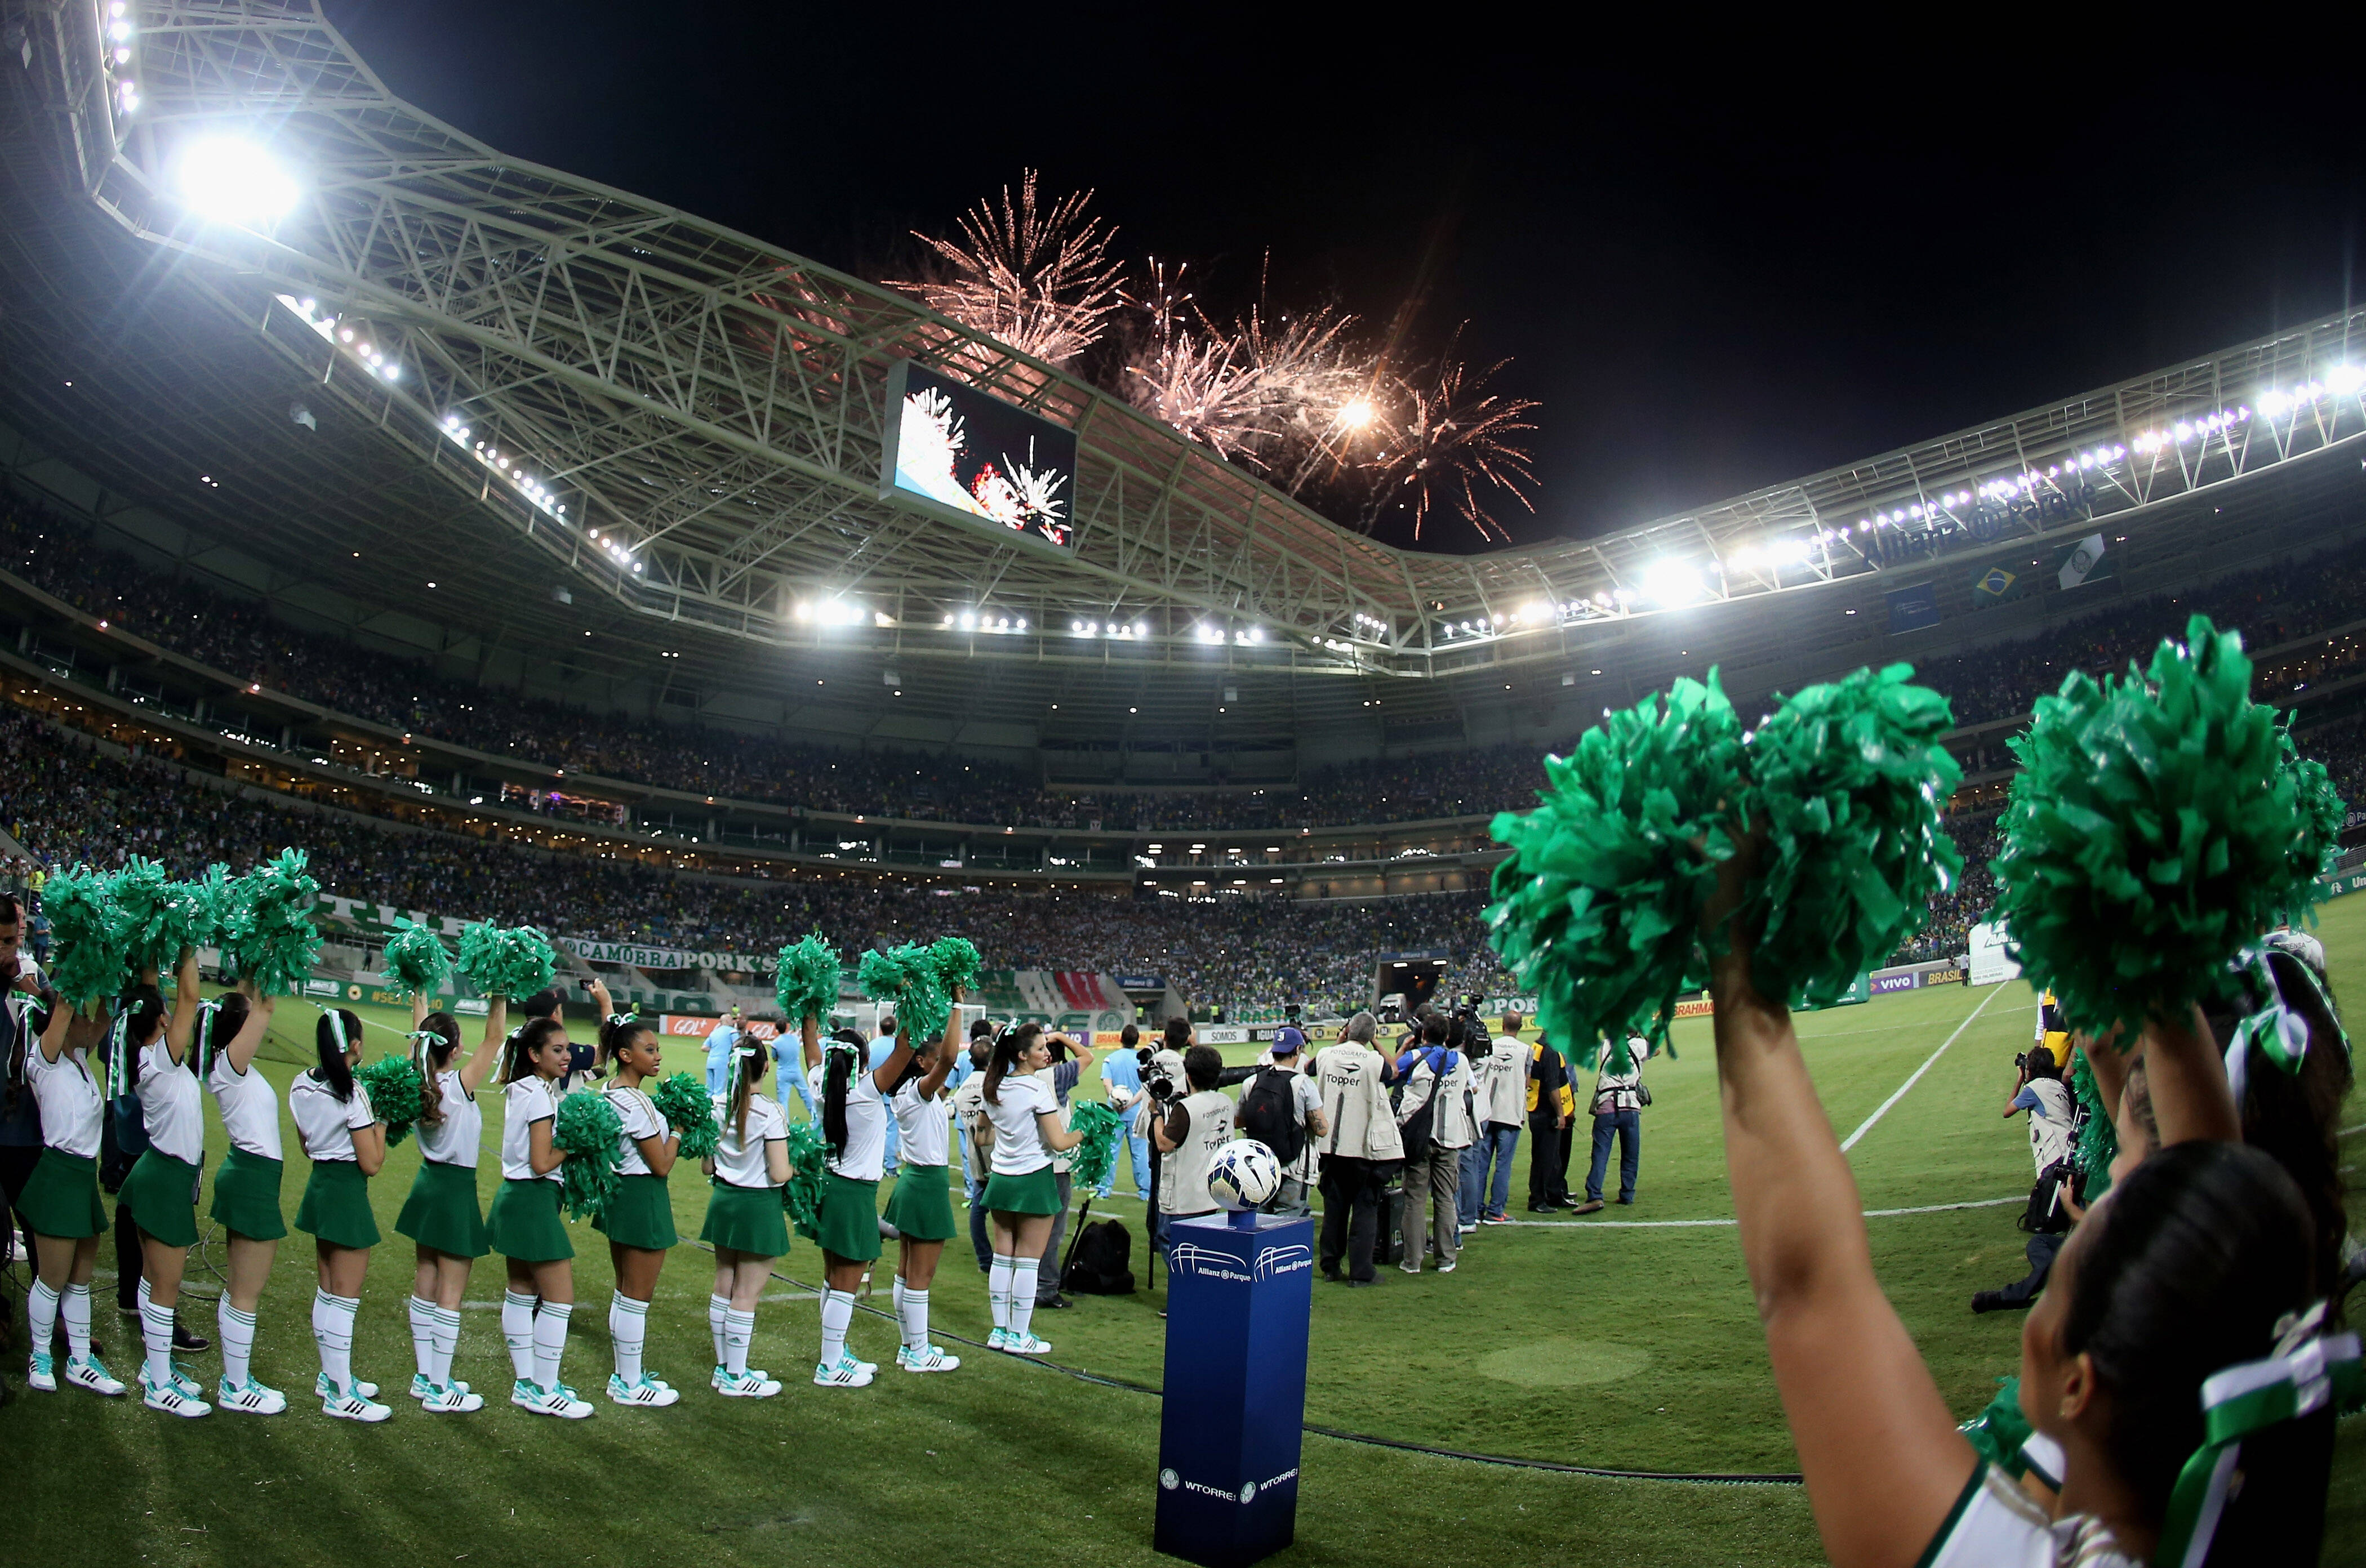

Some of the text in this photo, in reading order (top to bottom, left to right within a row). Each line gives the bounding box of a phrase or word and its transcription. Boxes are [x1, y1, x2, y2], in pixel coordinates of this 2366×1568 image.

[1880, 977, 1910, 990] VIVO
[1212, 1031, 1237, 1041] SOMOS
[1326, 1073, 1360, 1087] Topper
[1275, 1259, 1312, 1274] Allianz Parque
[1198, 1267, 1251, 1281] Allianz Parque
